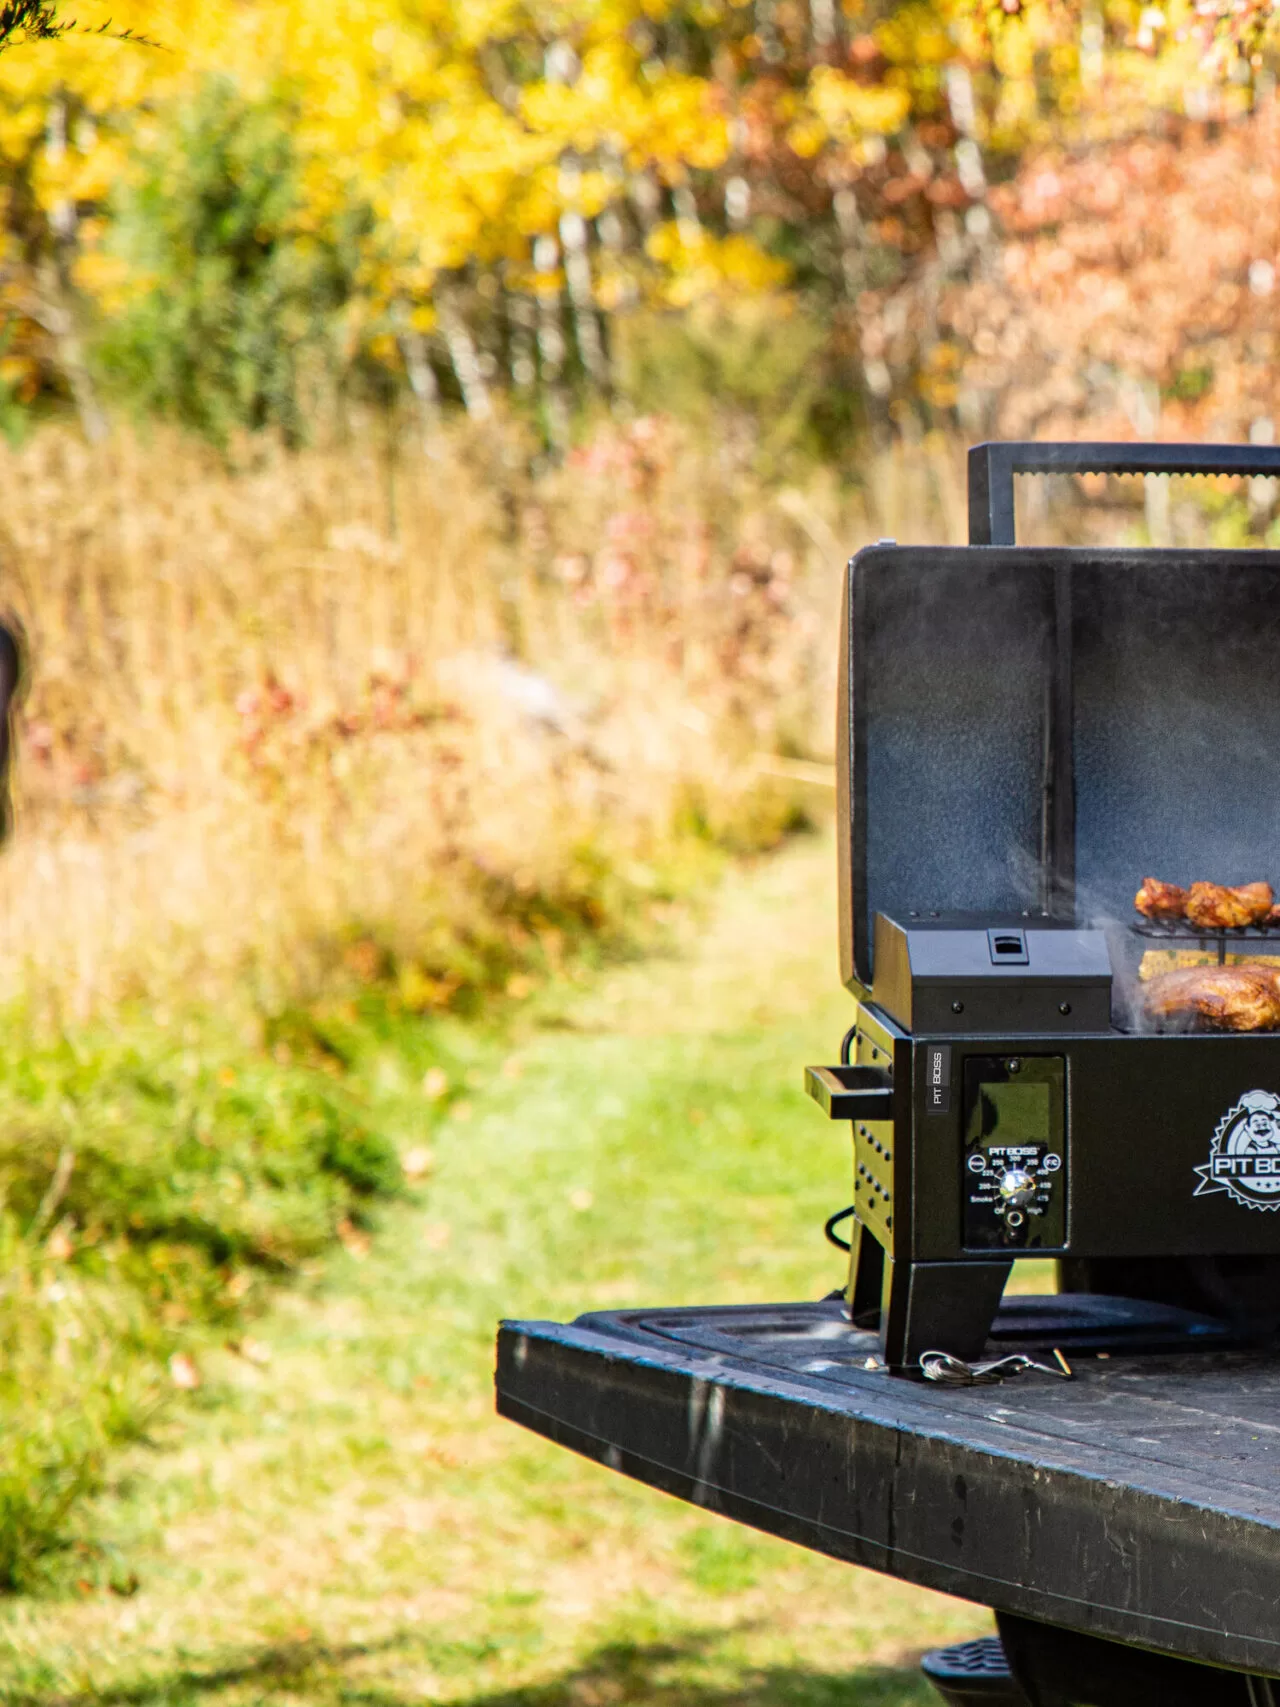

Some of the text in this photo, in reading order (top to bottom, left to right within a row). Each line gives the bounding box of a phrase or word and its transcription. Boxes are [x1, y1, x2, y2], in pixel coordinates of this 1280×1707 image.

[933, 1052, 942, 1104] PIT BOSS
[988, 1147, 1006, 1156] PIT
[1214, 1158, 1253, 1174] PIT
